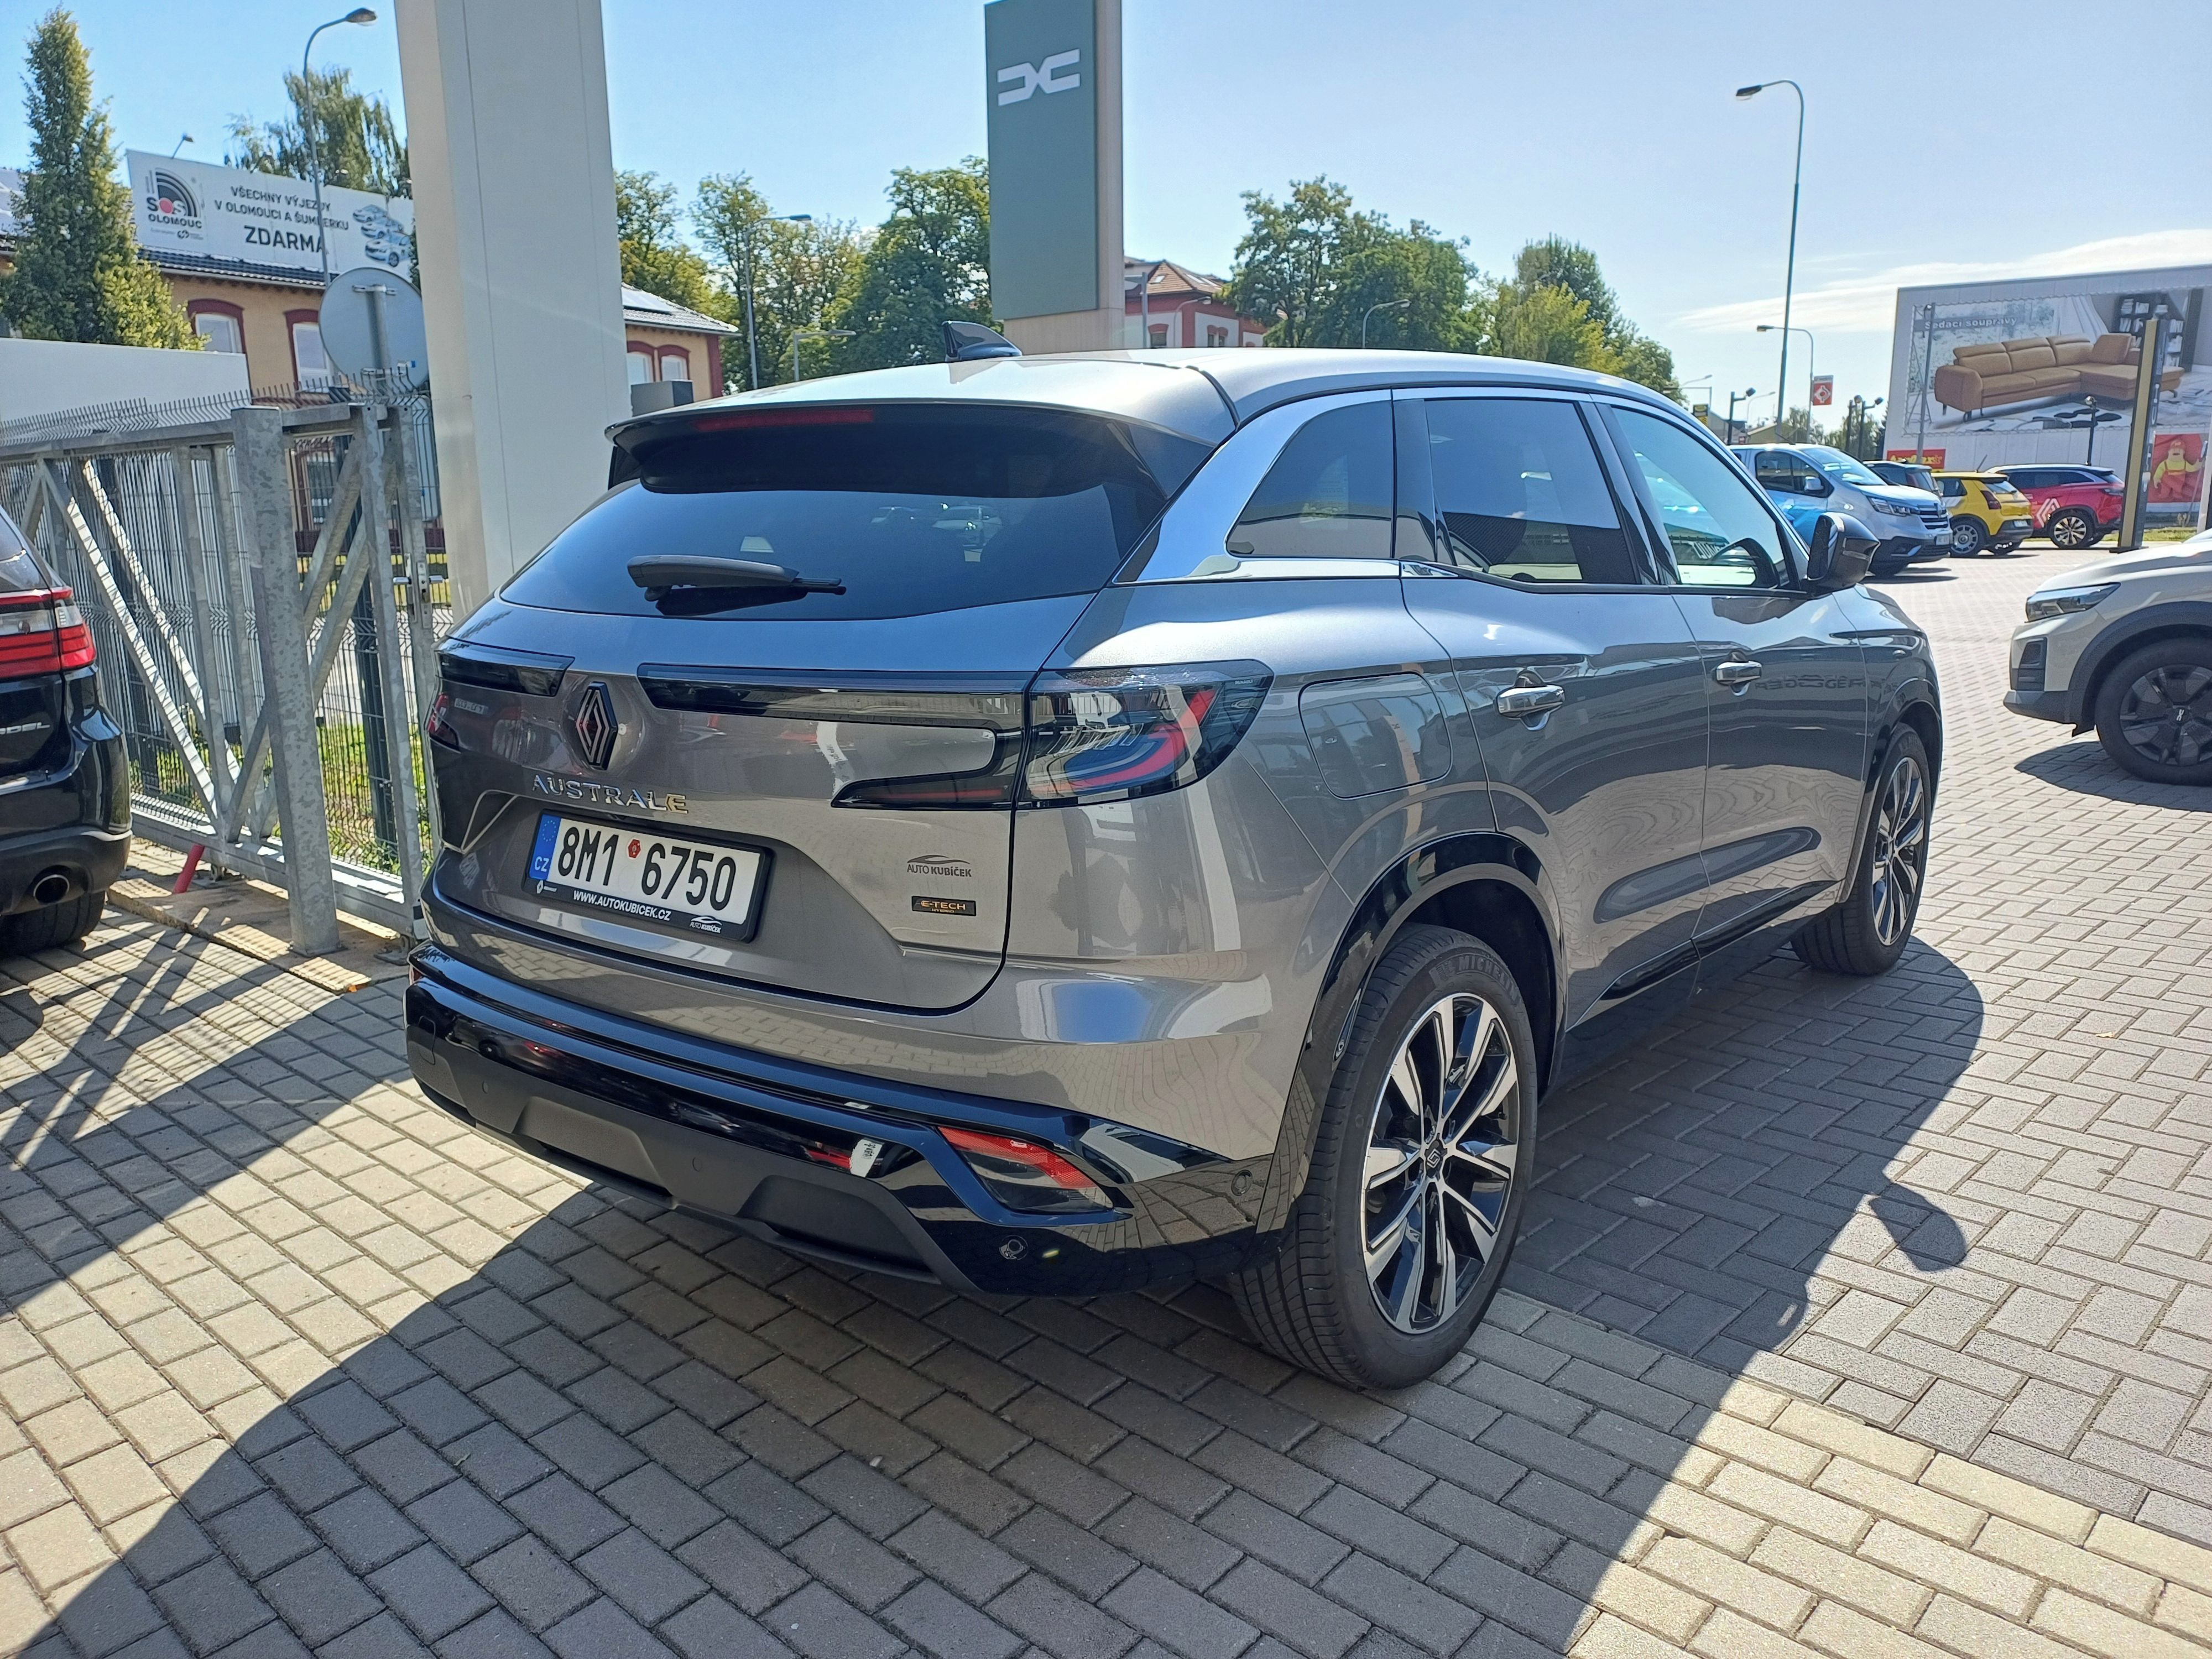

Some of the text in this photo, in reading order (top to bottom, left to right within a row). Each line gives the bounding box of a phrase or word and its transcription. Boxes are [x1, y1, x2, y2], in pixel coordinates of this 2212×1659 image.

[231, 185, 281, 204] VŠECHNY
[147, 197, 187, 216] SOS
[215, 200, 349, 230] V OLOMOUCI A ŠUMERKU
[148, 213, 202, 228] OLOMOUC
[244, 225, 329, 254] ZDARMA
[1965, 318, 2017, 327] soupravy
[534, 856, 549, 872] CZ
[558, 827, 736, 911] 8M1 6750
[907, 864, 972, 877] AUTO KUBÍČEK
[573, 890, 671, 921] WWW.AUTOKUBICEK.CZ
[920, 900, 966, 910] E-TECH
[1458, 955, 1520, 1003] MICHELIN
